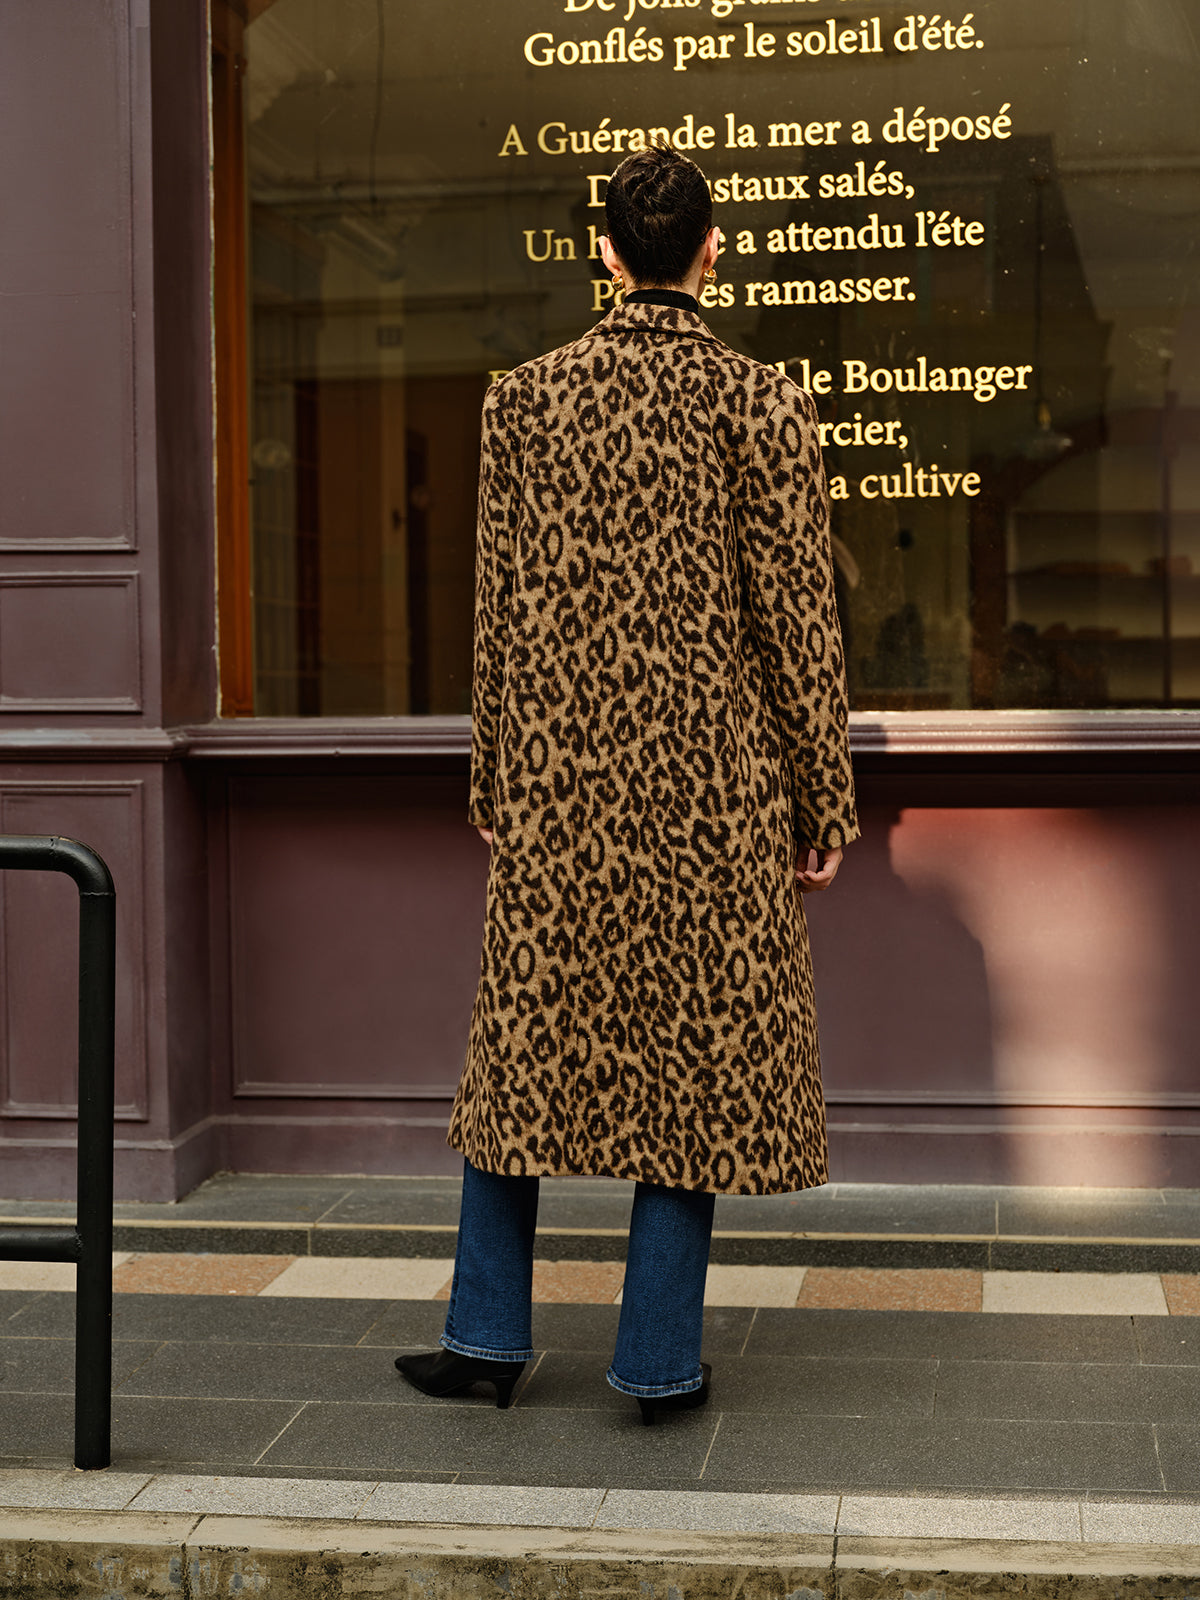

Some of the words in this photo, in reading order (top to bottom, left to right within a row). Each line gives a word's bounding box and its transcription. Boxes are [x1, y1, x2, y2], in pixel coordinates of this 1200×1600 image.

[523, 26, 664, 68] Gonflés
[673, 34, 736, 72] par
[744, 21, 777, 58] le
[785, 15, 885, 57] soleil
[893, 12, 985, 54] d’été.
[498, 123, 528, 157] A
[536, 113, 716, 157] Guérande
[724, 112, 759, 149] la
[767, 121, 842, 147] mer
[851, 120, 873, 145] a
[881, 102, 1012, 153] déposé
[705, 172, 811, 203] staux
[818, 160, 916, 200] salés,
[522, 229, 577, 262] Un
[735, 229, 759, 255] a
[766, 212, 906, 254] attendu
[699, 283, 736, 308] es
[744, 276, 917, 307] ramasser.
[800, 358, 832, 395] le
[842, 356, 1033, 403] Boulanger
[817, 412, 909, 450] rcier,
[829, 475, 850, 500] a
[859, 461, 982, 499] cultive
